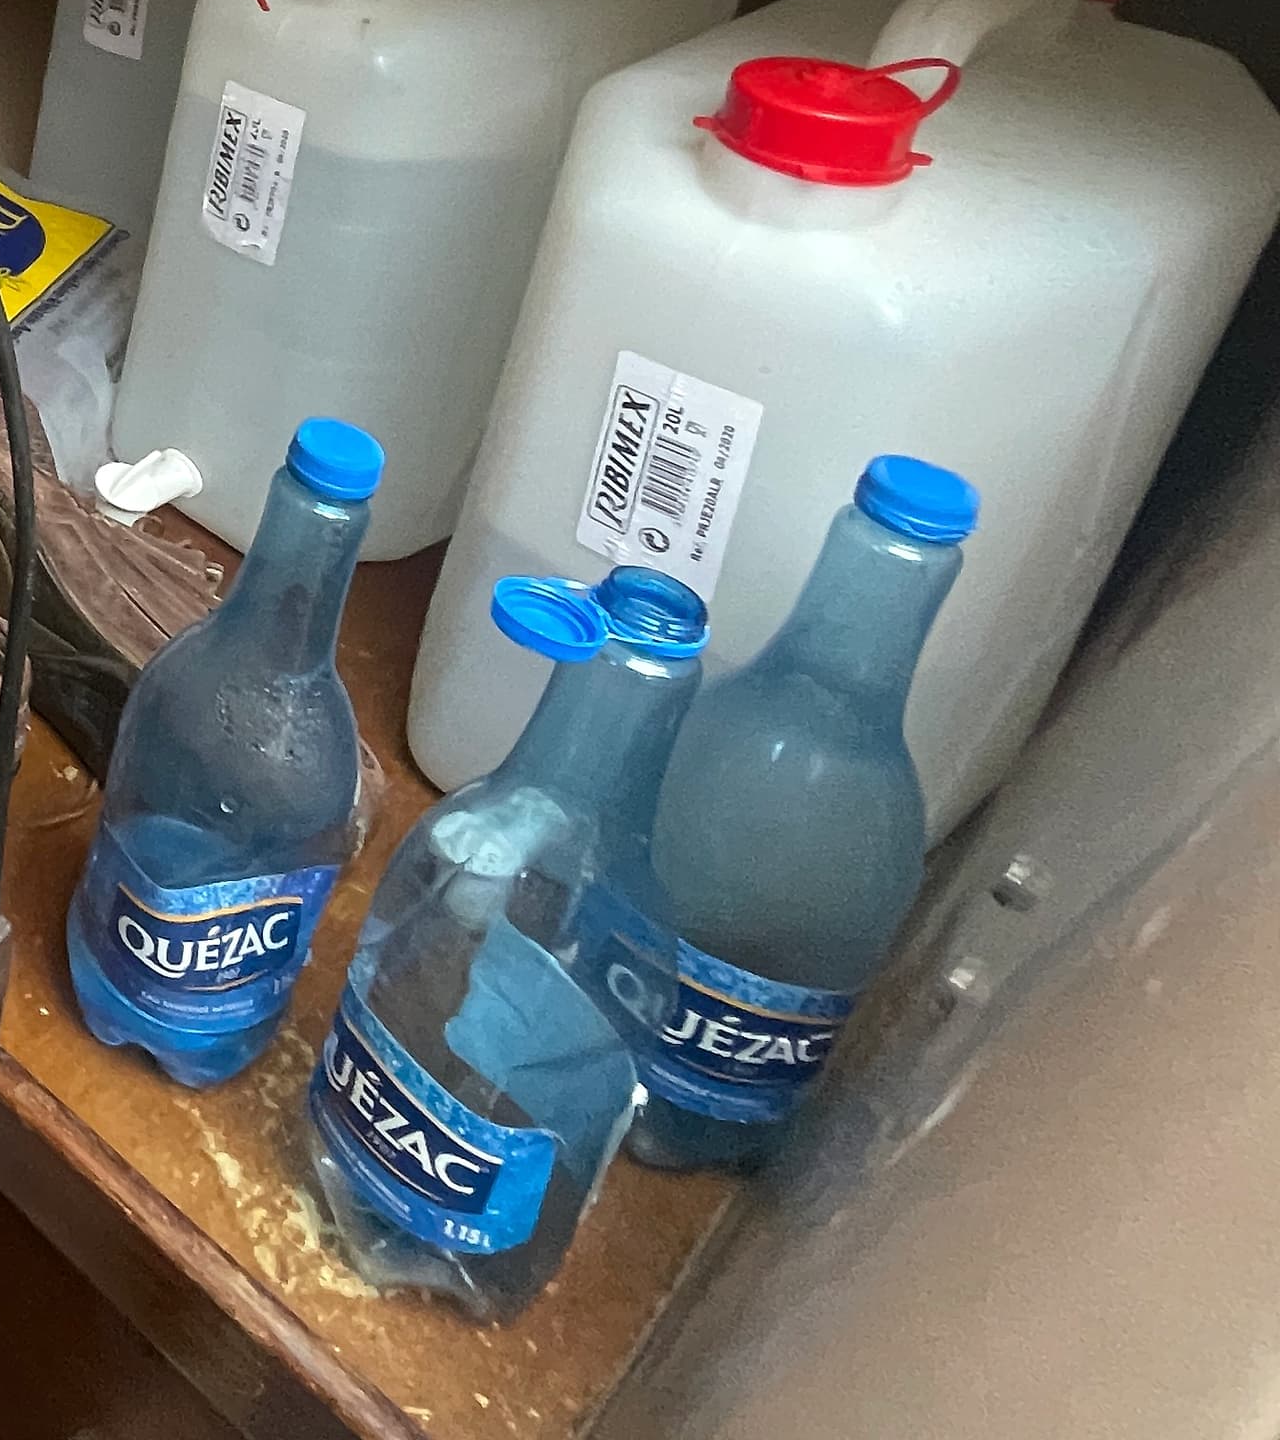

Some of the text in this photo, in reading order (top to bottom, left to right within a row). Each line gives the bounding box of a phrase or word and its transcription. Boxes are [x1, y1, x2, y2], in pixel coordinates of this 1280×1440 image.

[208, 111, 243, 216] RIBIMEX
[594, 391, 652, 529] RIBIMEX
[662, 406, 685, 436] 20L
[117, 911, 290, 979] QUÉZAC
